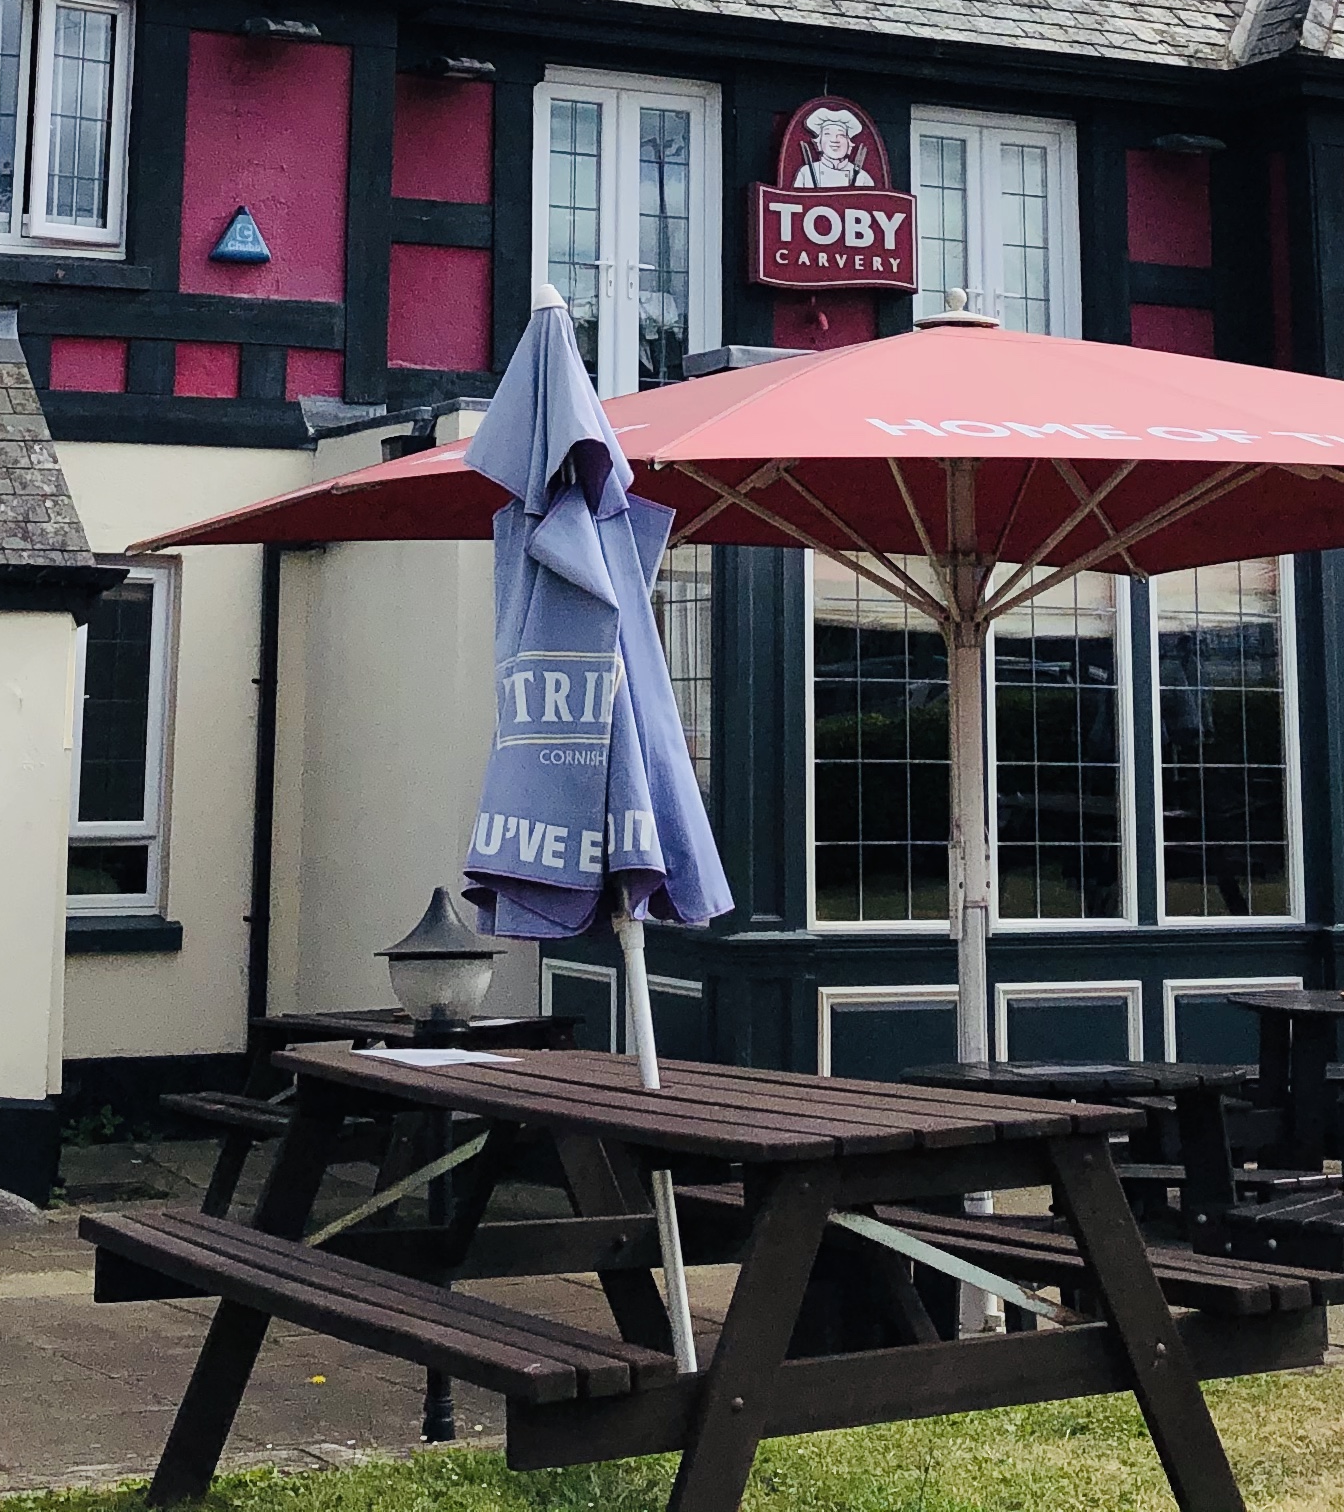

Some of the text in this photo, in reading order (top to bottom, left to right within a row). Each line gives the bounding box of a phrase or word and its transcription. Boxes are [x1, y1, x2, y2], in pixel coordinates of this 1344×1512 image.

[769, 202, 906, 250] TOBY
[775, 249, 901, 273] CARVERY
[864, 418, 1143, 441] HOME
[1146, 426, 1263, 445] OF
[539, 749, 607, 766] CORNISH
[470, 812, 569, 869] U'VE
